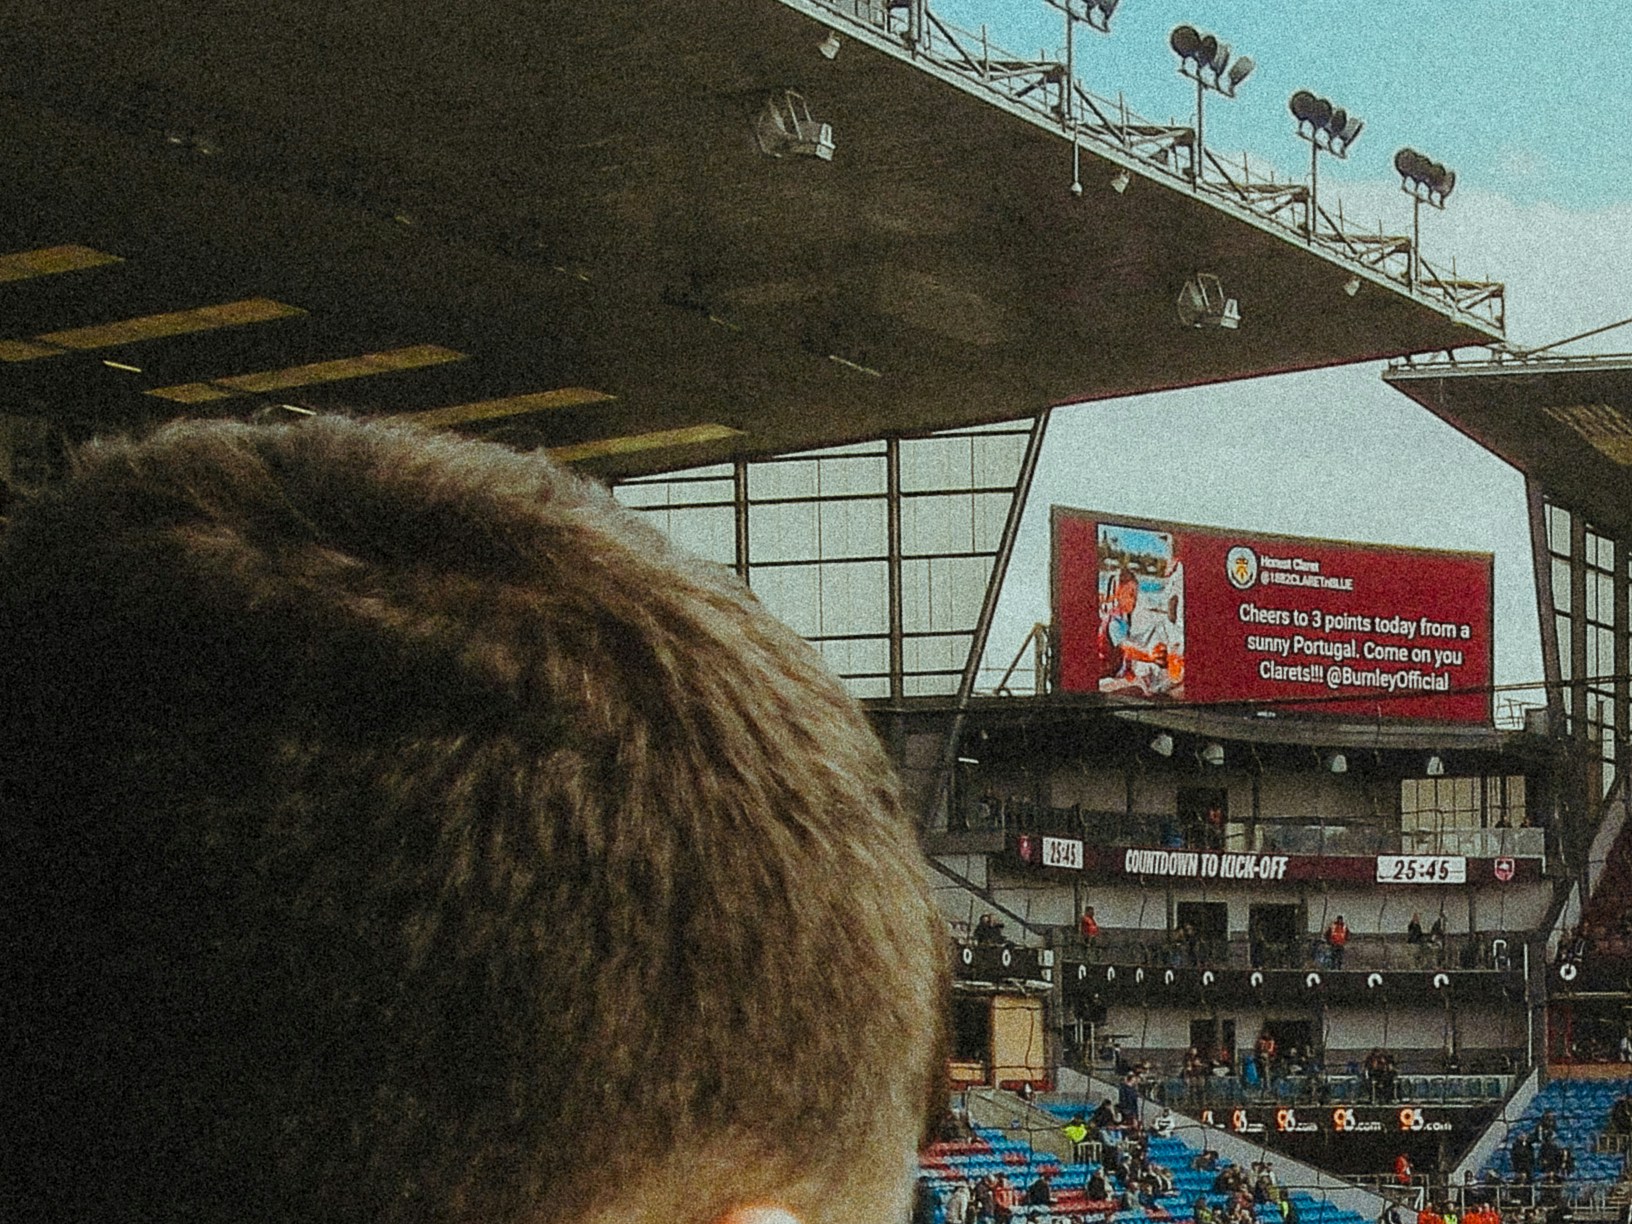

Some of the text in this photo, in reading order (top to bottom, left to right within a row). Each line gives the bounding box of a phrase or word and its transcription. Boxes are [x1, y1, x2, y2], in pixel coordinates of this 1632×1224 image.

[1239, 603, 1470, 639] Cheers to 3 points today from a
[1247, 635, 1462, 668] sunny Portugal. Come on you
[1260, 661, 1449, 692] Clarets!!! @BurnleyOfficial
[1125, 849, 1289, 880] COUNTDOWN TO KICK-OFF
[1393, 859, 1450, 881] 25:45
